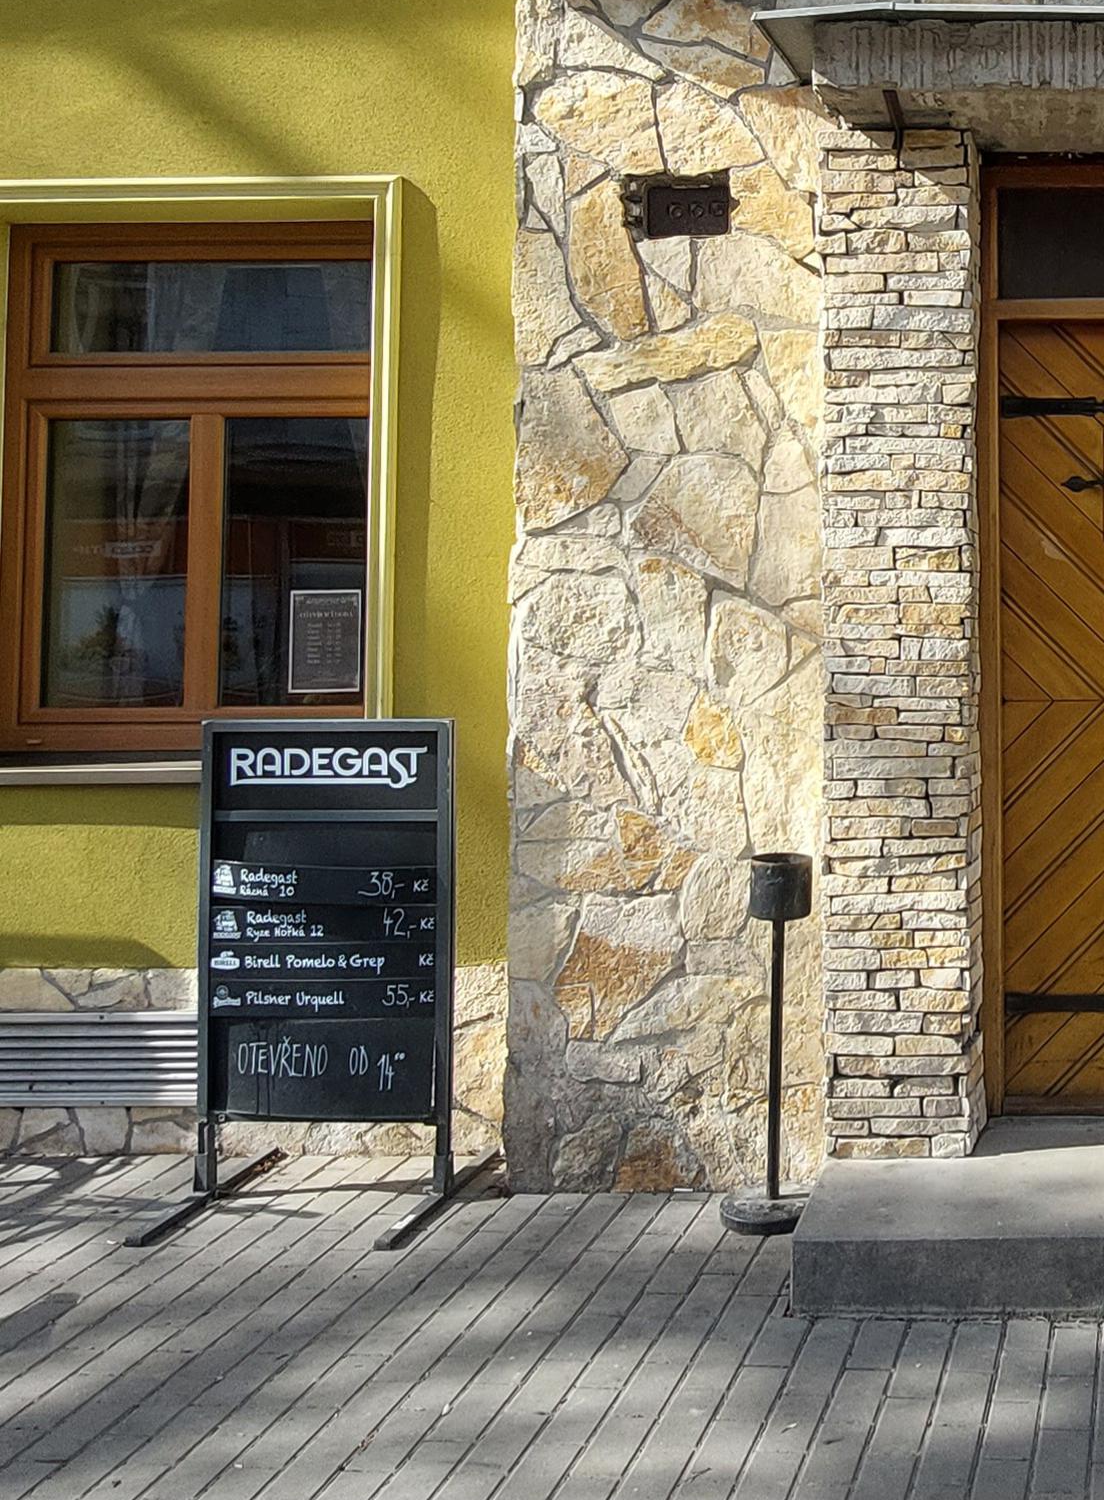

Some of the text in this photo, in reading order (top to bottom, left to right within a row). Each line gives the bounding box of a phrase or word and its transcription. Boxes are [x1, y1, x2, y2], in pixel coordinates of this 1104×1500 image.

[229, 746, 428, 789] RADEGAST
[240, 867, 298, 888] Radegast
[413, 879, 430, 893] Kč
[279, 886, 295, 897] 10
[247, 909, 307, 929] Radegast
[420, 917, 435, 930] Kč
[310, 925, 324, 937] 12
[244, 954, 281, 969] Birell
[286, 954, 336, 969] Pomelo
[349, 953, 385, 975] Grep
[418, 953, 435, 967] Kč
[246, 990, 292, 1005] Pilsner
[296, 990, 345, 1012] Urquell
[419, 990, 435, 1003] Kč
[238, 1035, 329, 1077] OTEVŘENO
